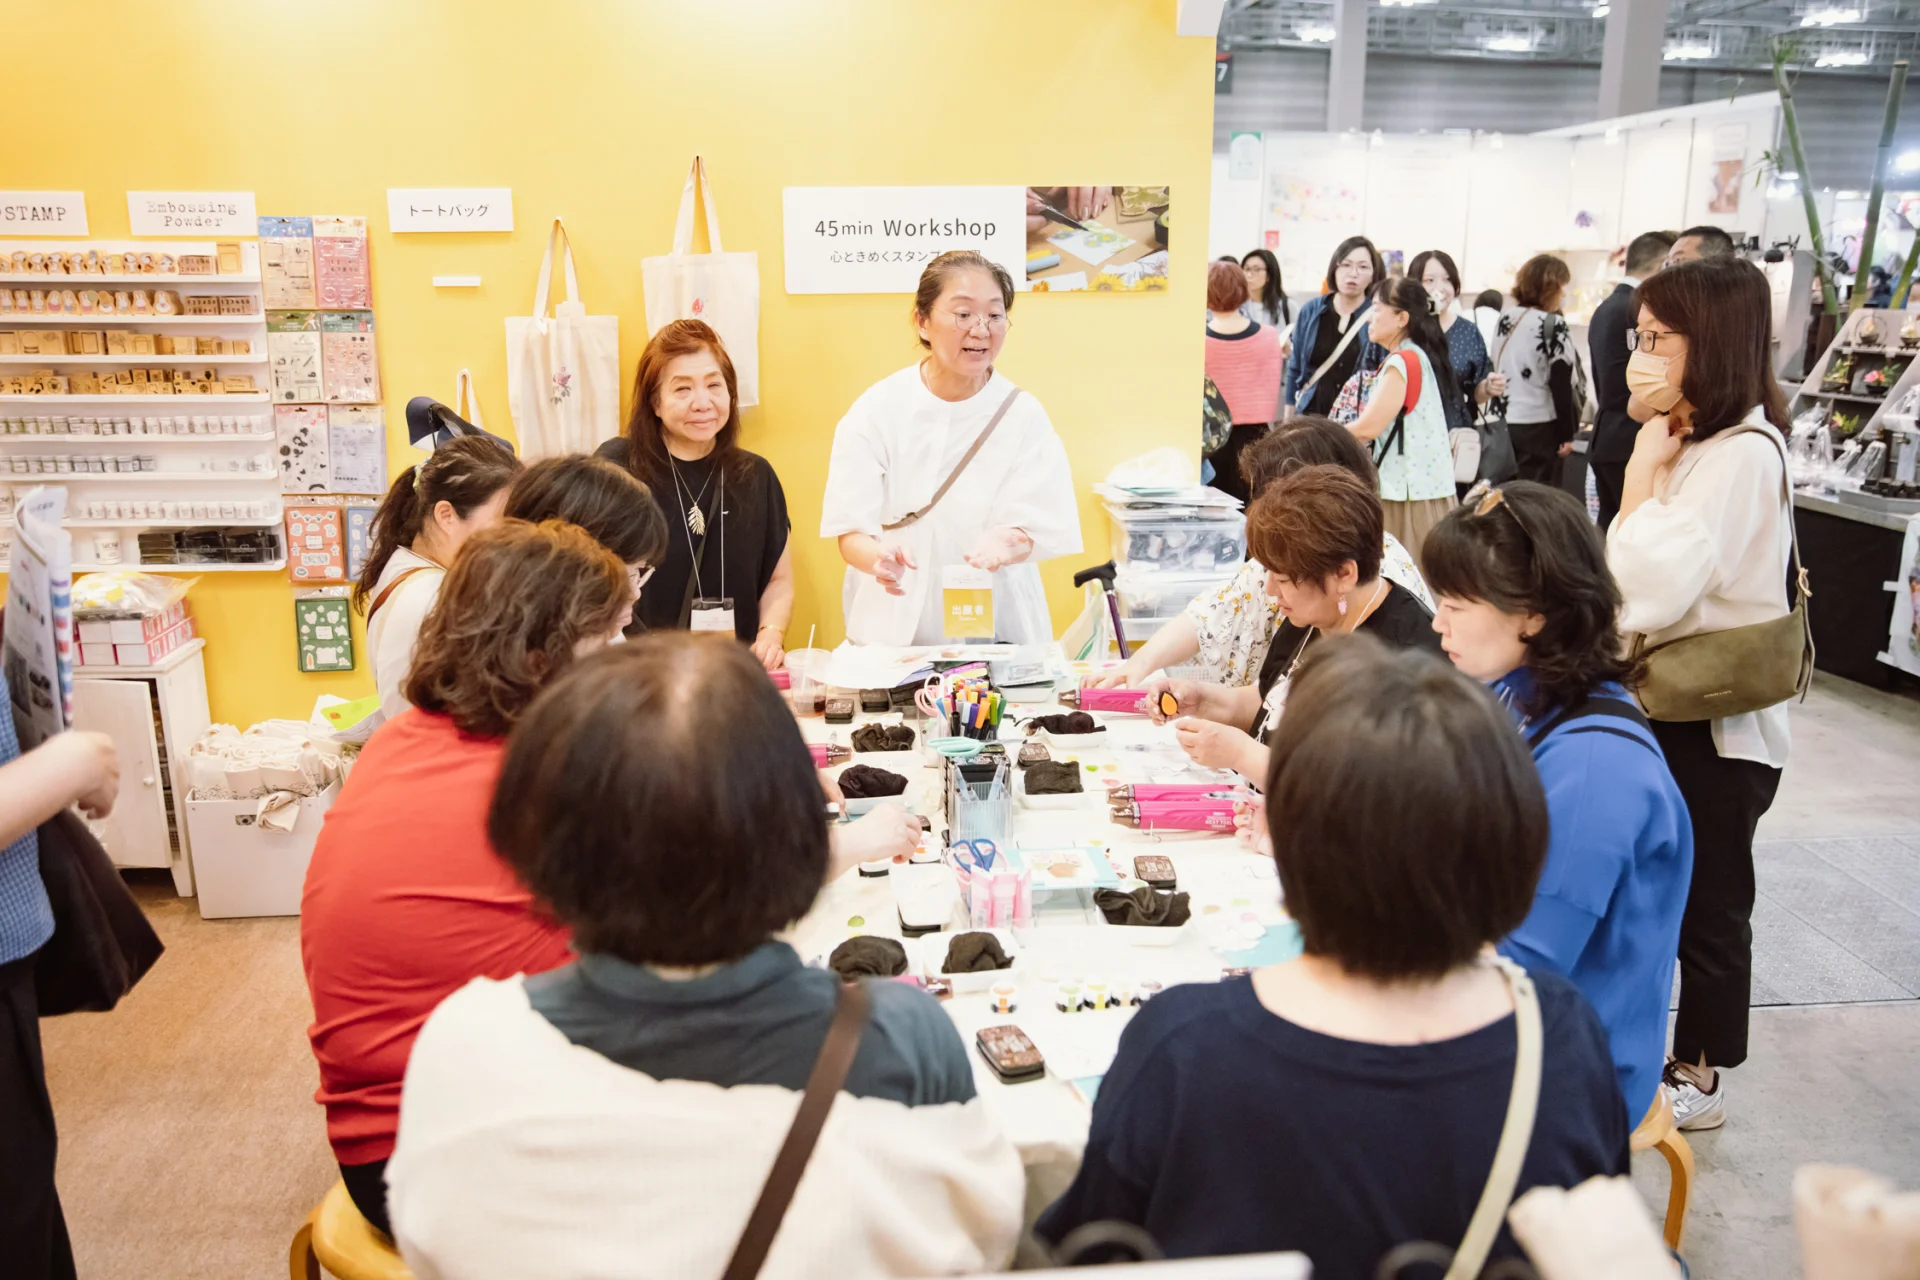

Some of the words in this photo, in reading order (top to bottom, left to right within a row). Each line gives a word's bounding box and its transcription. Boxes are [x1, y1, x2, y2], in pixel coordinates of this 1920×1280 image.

[0, 206, 66, 221] STAMP
[146, 201, 237, 216] Embossing
[410, 204, 490, 217] トートバッグ
[164, 215, 223, 227] Powder
[815, 219, 873, 237] 45min
[883, 218, 996, 240] Workshop
